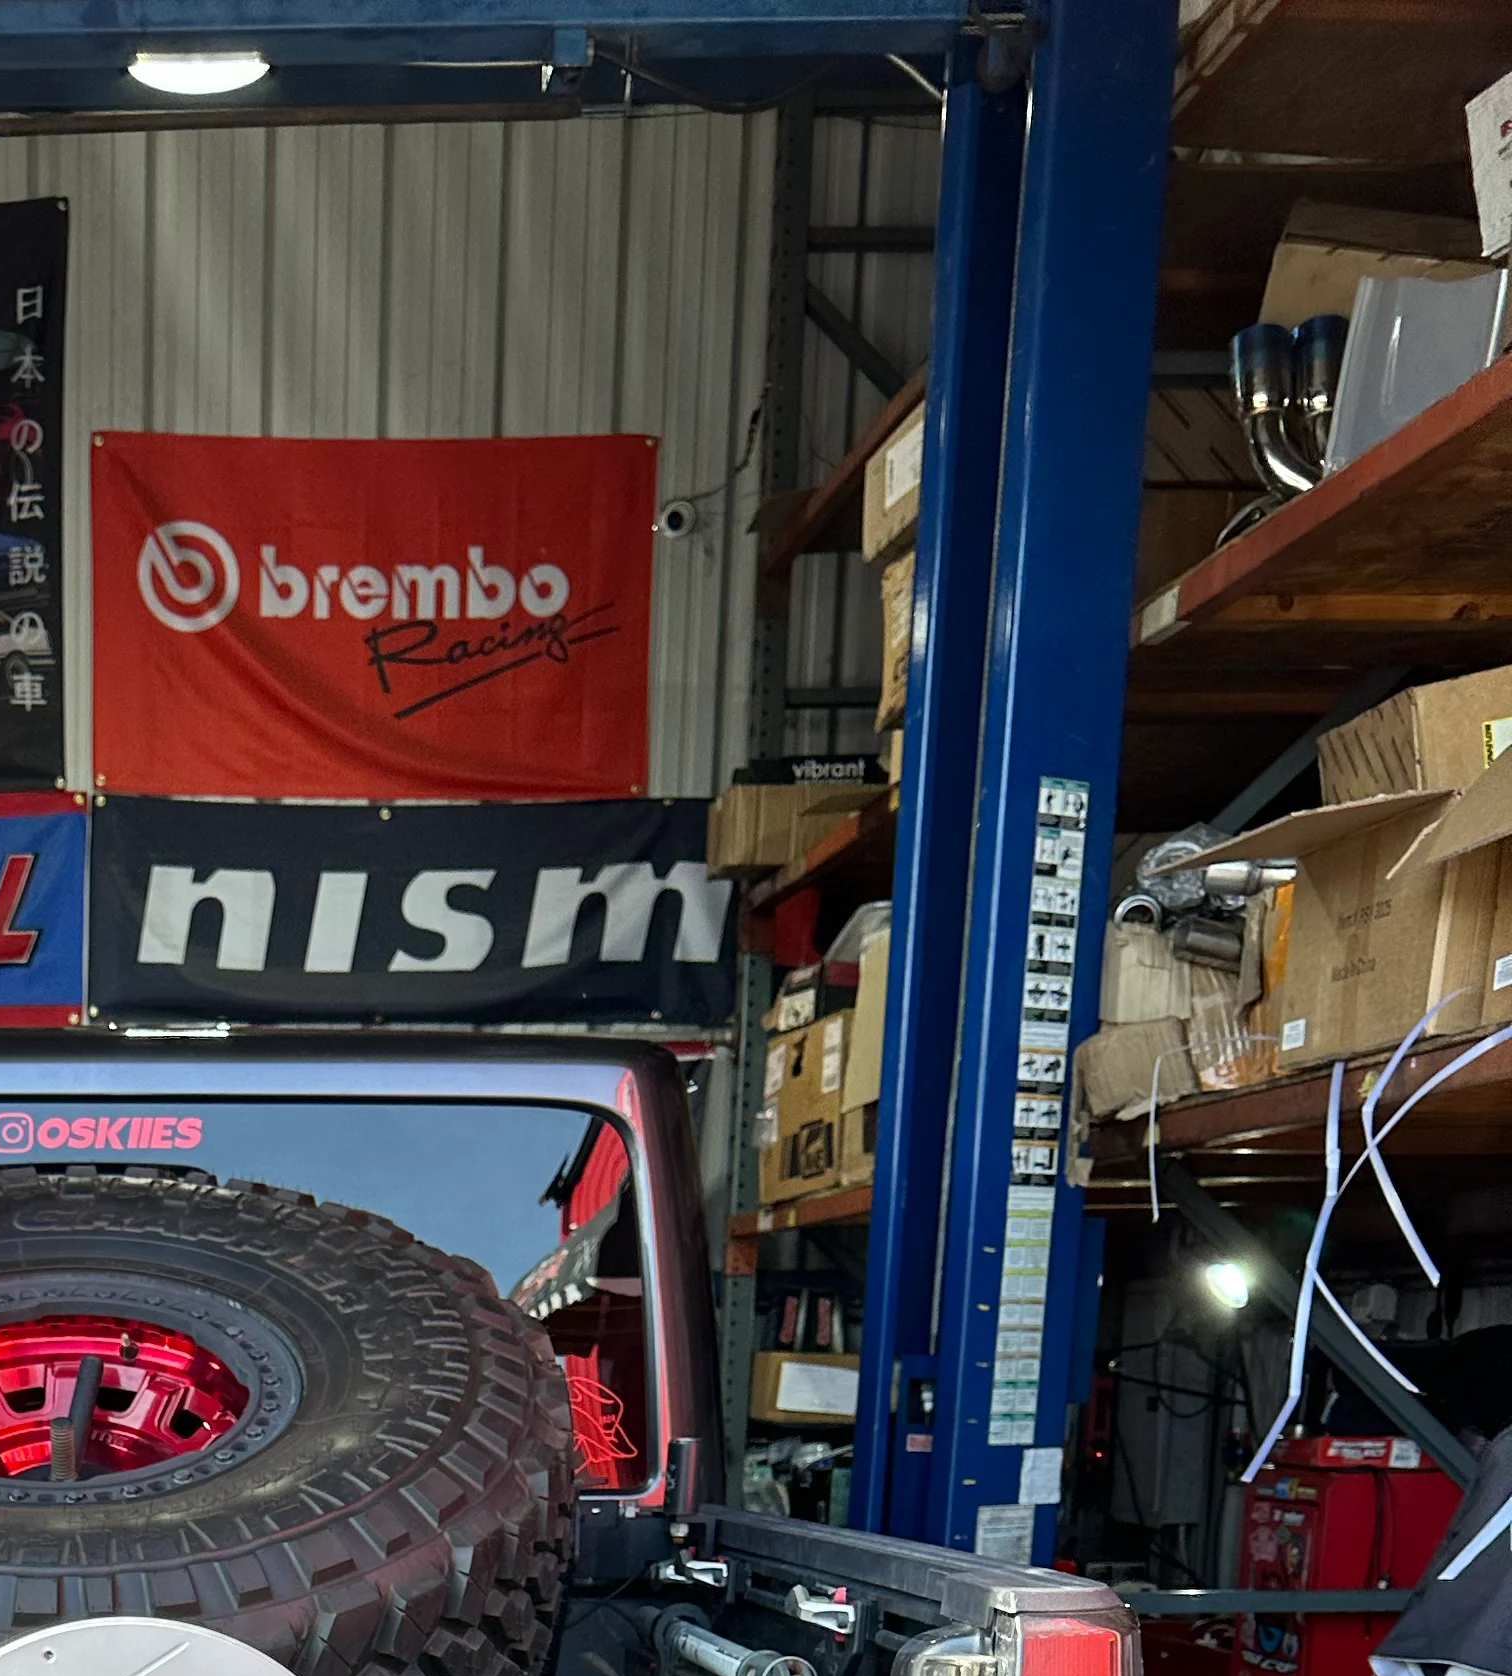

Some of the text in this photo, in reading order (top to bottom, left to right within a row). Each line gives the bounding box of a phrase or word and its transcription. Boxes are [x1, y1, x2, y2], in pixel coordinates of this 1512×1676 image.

[6, 284, 48, 712] 日本の伝説の車
[259, 544, 571, 620] brembo
[366, 610, 574, 695] Racing
[791, 757, 865, 779] vibrant
[37, 1117, 203, 1150] OSKIIES
